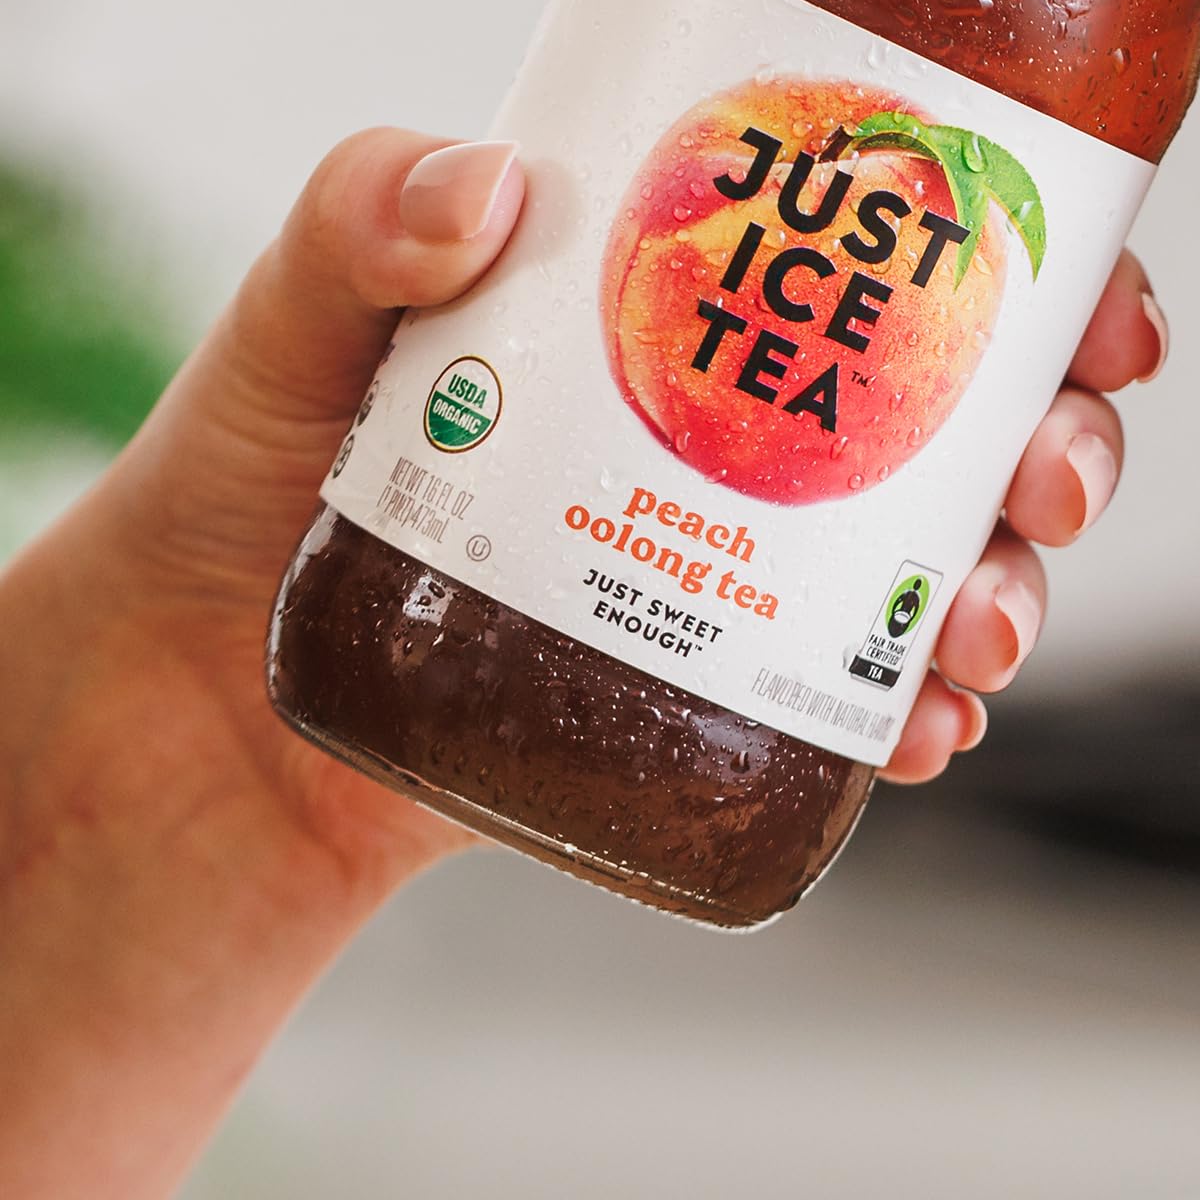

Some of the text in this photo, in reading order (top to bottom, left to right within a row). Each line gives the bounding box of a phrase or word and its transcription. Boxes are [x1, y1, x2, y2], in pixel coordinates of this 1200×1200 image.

[712, 126, 972, 289] JUST
[718, 221, 895, 355] ICE
[432, 398, 482, 435] ORGANIC
[447, 373, 488, 410] USDA
[388, 456, 475, 521] NET WT 16 FL OZ
[621, 486, 758, 564] peach
[563, 503, 782, 622] oolong tea
[582, 567, 724, 644] JUST SWEET
[865, 646, 901, 666] CERTIFIED
[867, 665, 884, 681] TEA
[868, 634, 907, 657] FAIR TRADE
[750, 667, 811, 713] FLAVORED
[806, 689, 835, 722] WITH
